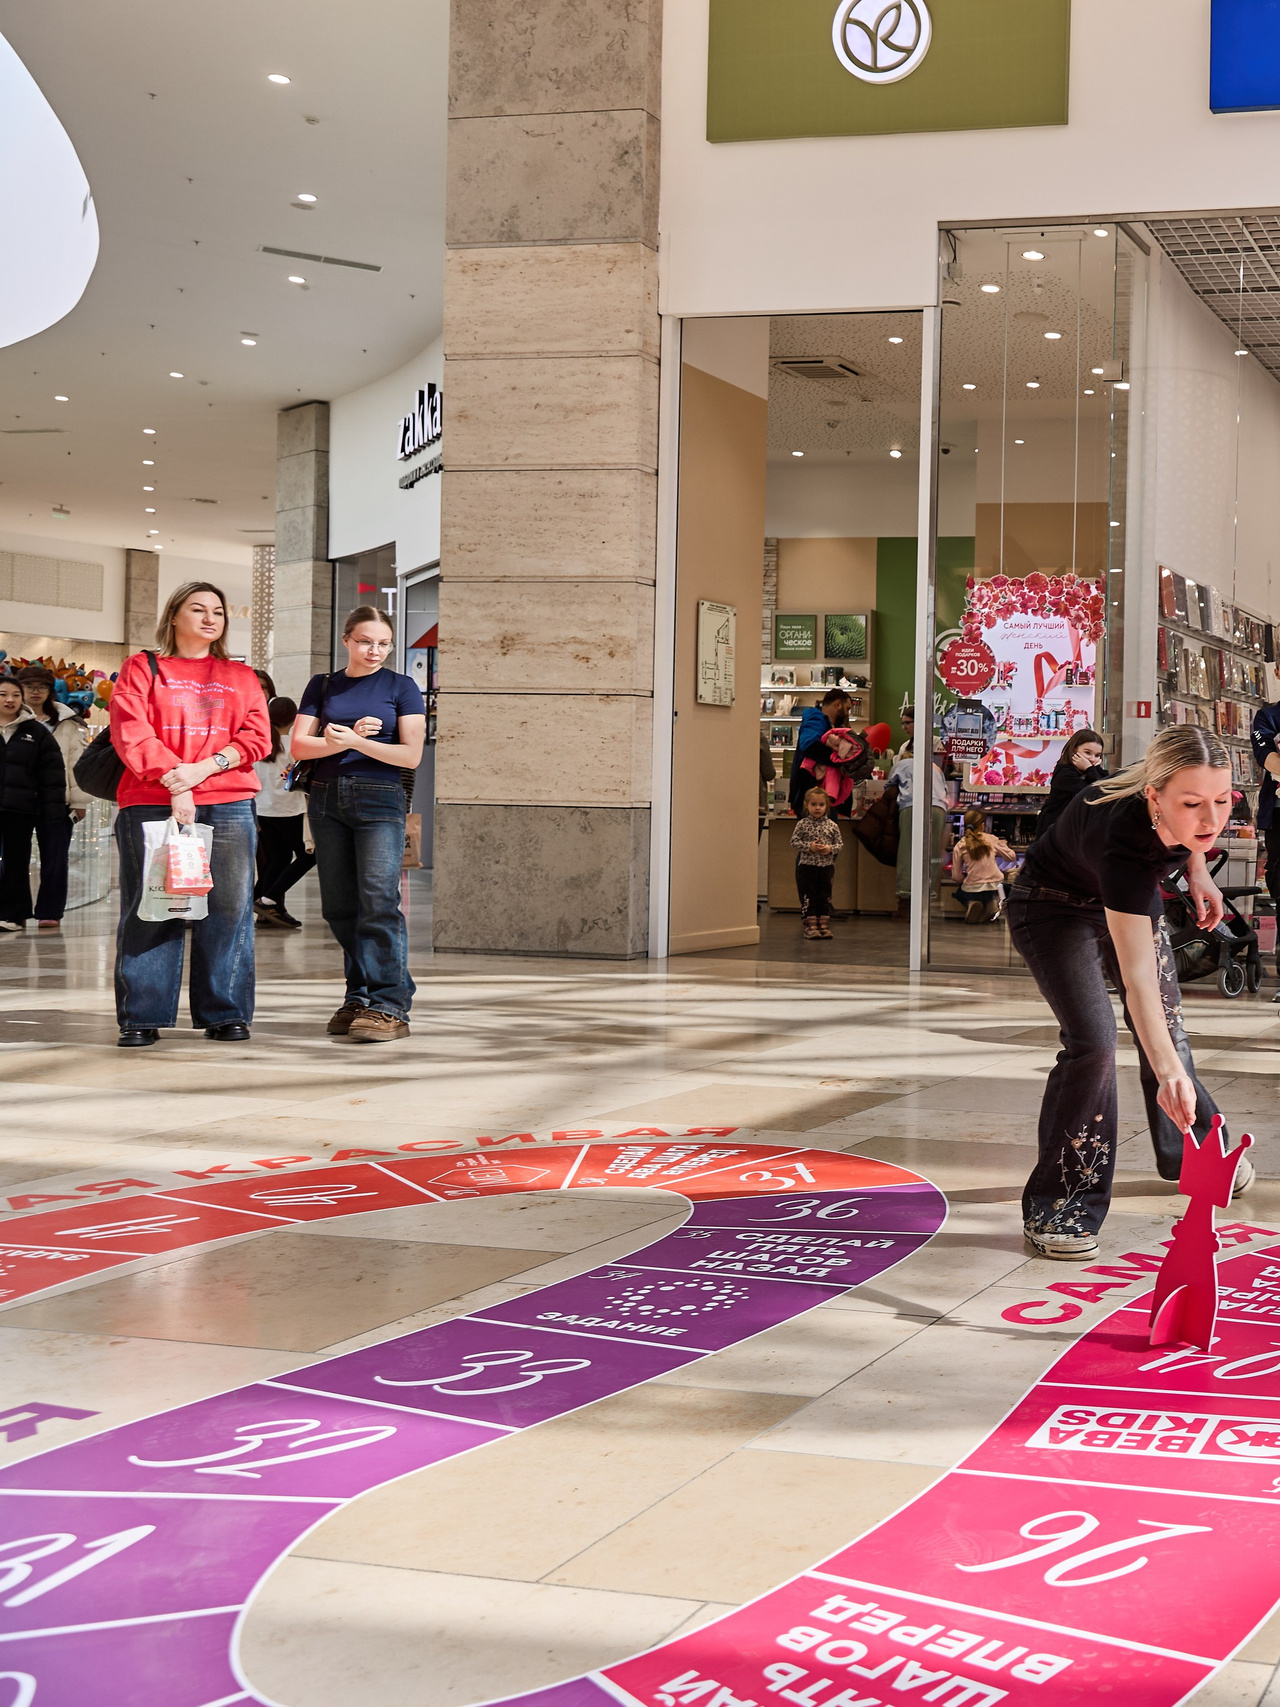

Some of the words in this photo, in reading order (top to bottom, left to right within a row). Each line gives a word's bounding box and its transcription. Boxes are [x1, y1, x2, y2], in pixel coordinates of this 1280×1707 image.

[397, 382, 442, 461] zakka
[779, 630, 813, 639] ОРГАНИ-
[1003, 621, 1031, 630] САМЫЙ
[1032, 621, 1065, 630] ЛУЧШИЙ
[1023, 642, 1043, 650] ДЕНЬ
[951, 739, 984, 747] ПОДАРКИ
[0, 1179, 160, 1213] АЯ
[173, 1127, 740, 1180] КРАСИВАЯ
[604, 1146, 656, 1174] СДЕЛАЙ
[626, 1163, 668, 1179] ДВА
[651, 1144, 704, 1163] ШАГА
[659, 1149, 747, 1176] ВПЕРЕД
[739, 1162, 817, 1192] 37
[250, 1184, 379, 1207] 40
[747, 1197, 873, 1222] 36
[54, 1214, 201, 1240] 41
[734, 1231, 897, 1250] СДЕЛАЙ
[0, 1247, 91, 1261] ЗАДА
[705, 1249, 853, 1268] ШАГОВ
[743, 1241, 847, 1256] ПЯТЬ
[688, 1260, 832, 1279] НАЗАД
[1001, 1223, 1280, 1325] САМЯ
[536, 1311, 688, 1338] ЗАДАНИЕ
[373, 1350, 592, 1396] 33
[1057, 1408, 1210, 1434] KIDS
[127, 1418, 398, 1478] 32
[1047, 1426, 1198, 1454] BEBA
[953, 1509, 1213, 1588] 26
[808, 1593, 1075, 1685] ВПЕРЕД
[775, 1625, 1010, 1707] ШАГОВ
[762, 1661, 900, 1707] ЯТЬ
